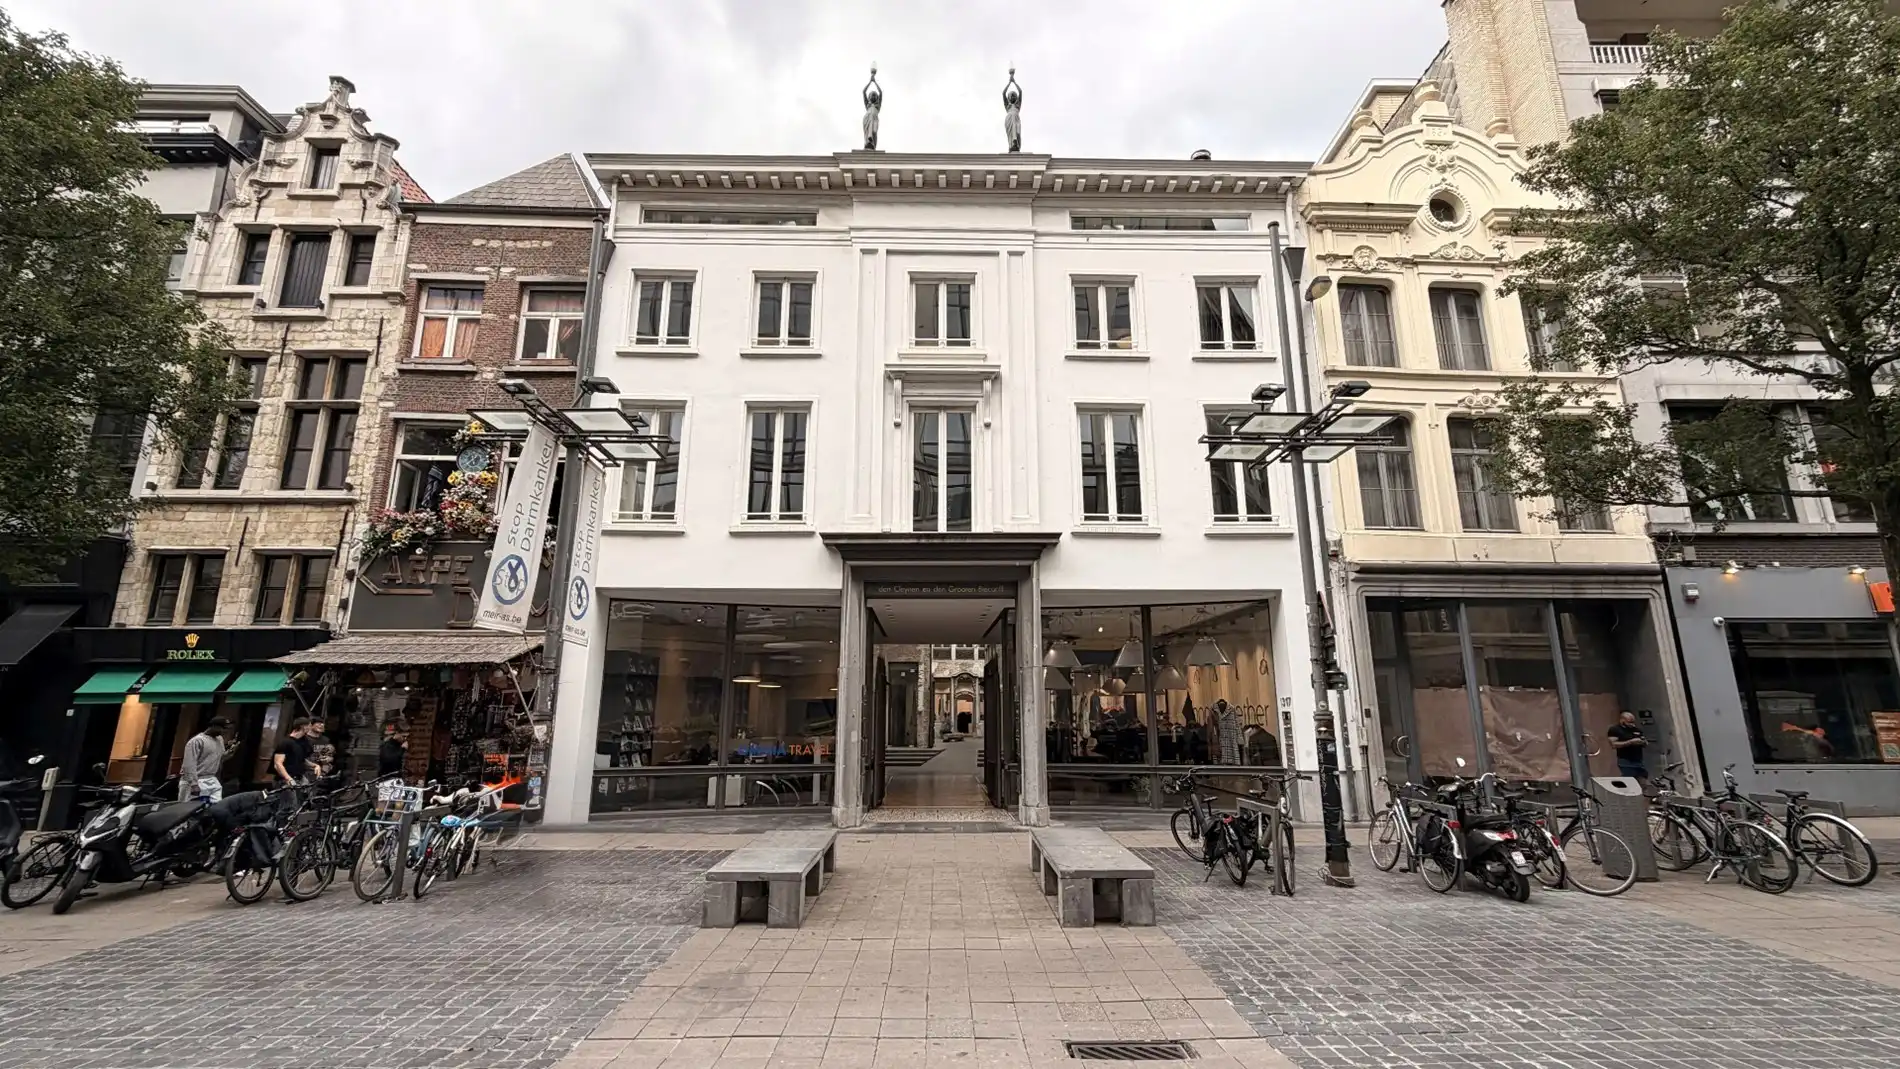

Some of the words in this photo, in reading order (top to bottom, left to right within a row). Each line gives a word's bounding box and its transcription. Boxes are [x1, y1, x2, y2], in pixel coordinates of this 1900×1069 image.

[520, 438, 554, 552] Darmkanker
[507, 502, 524, 547] Stop
[582, 475, 602, 574] Darmkanker
[574, 529, 585, 569] Stop
[482, 609, 522, 624] meir-as.be
[166, 649, 215, 660] ROLEX
[788, 744, 830, 756] TRAVEL
